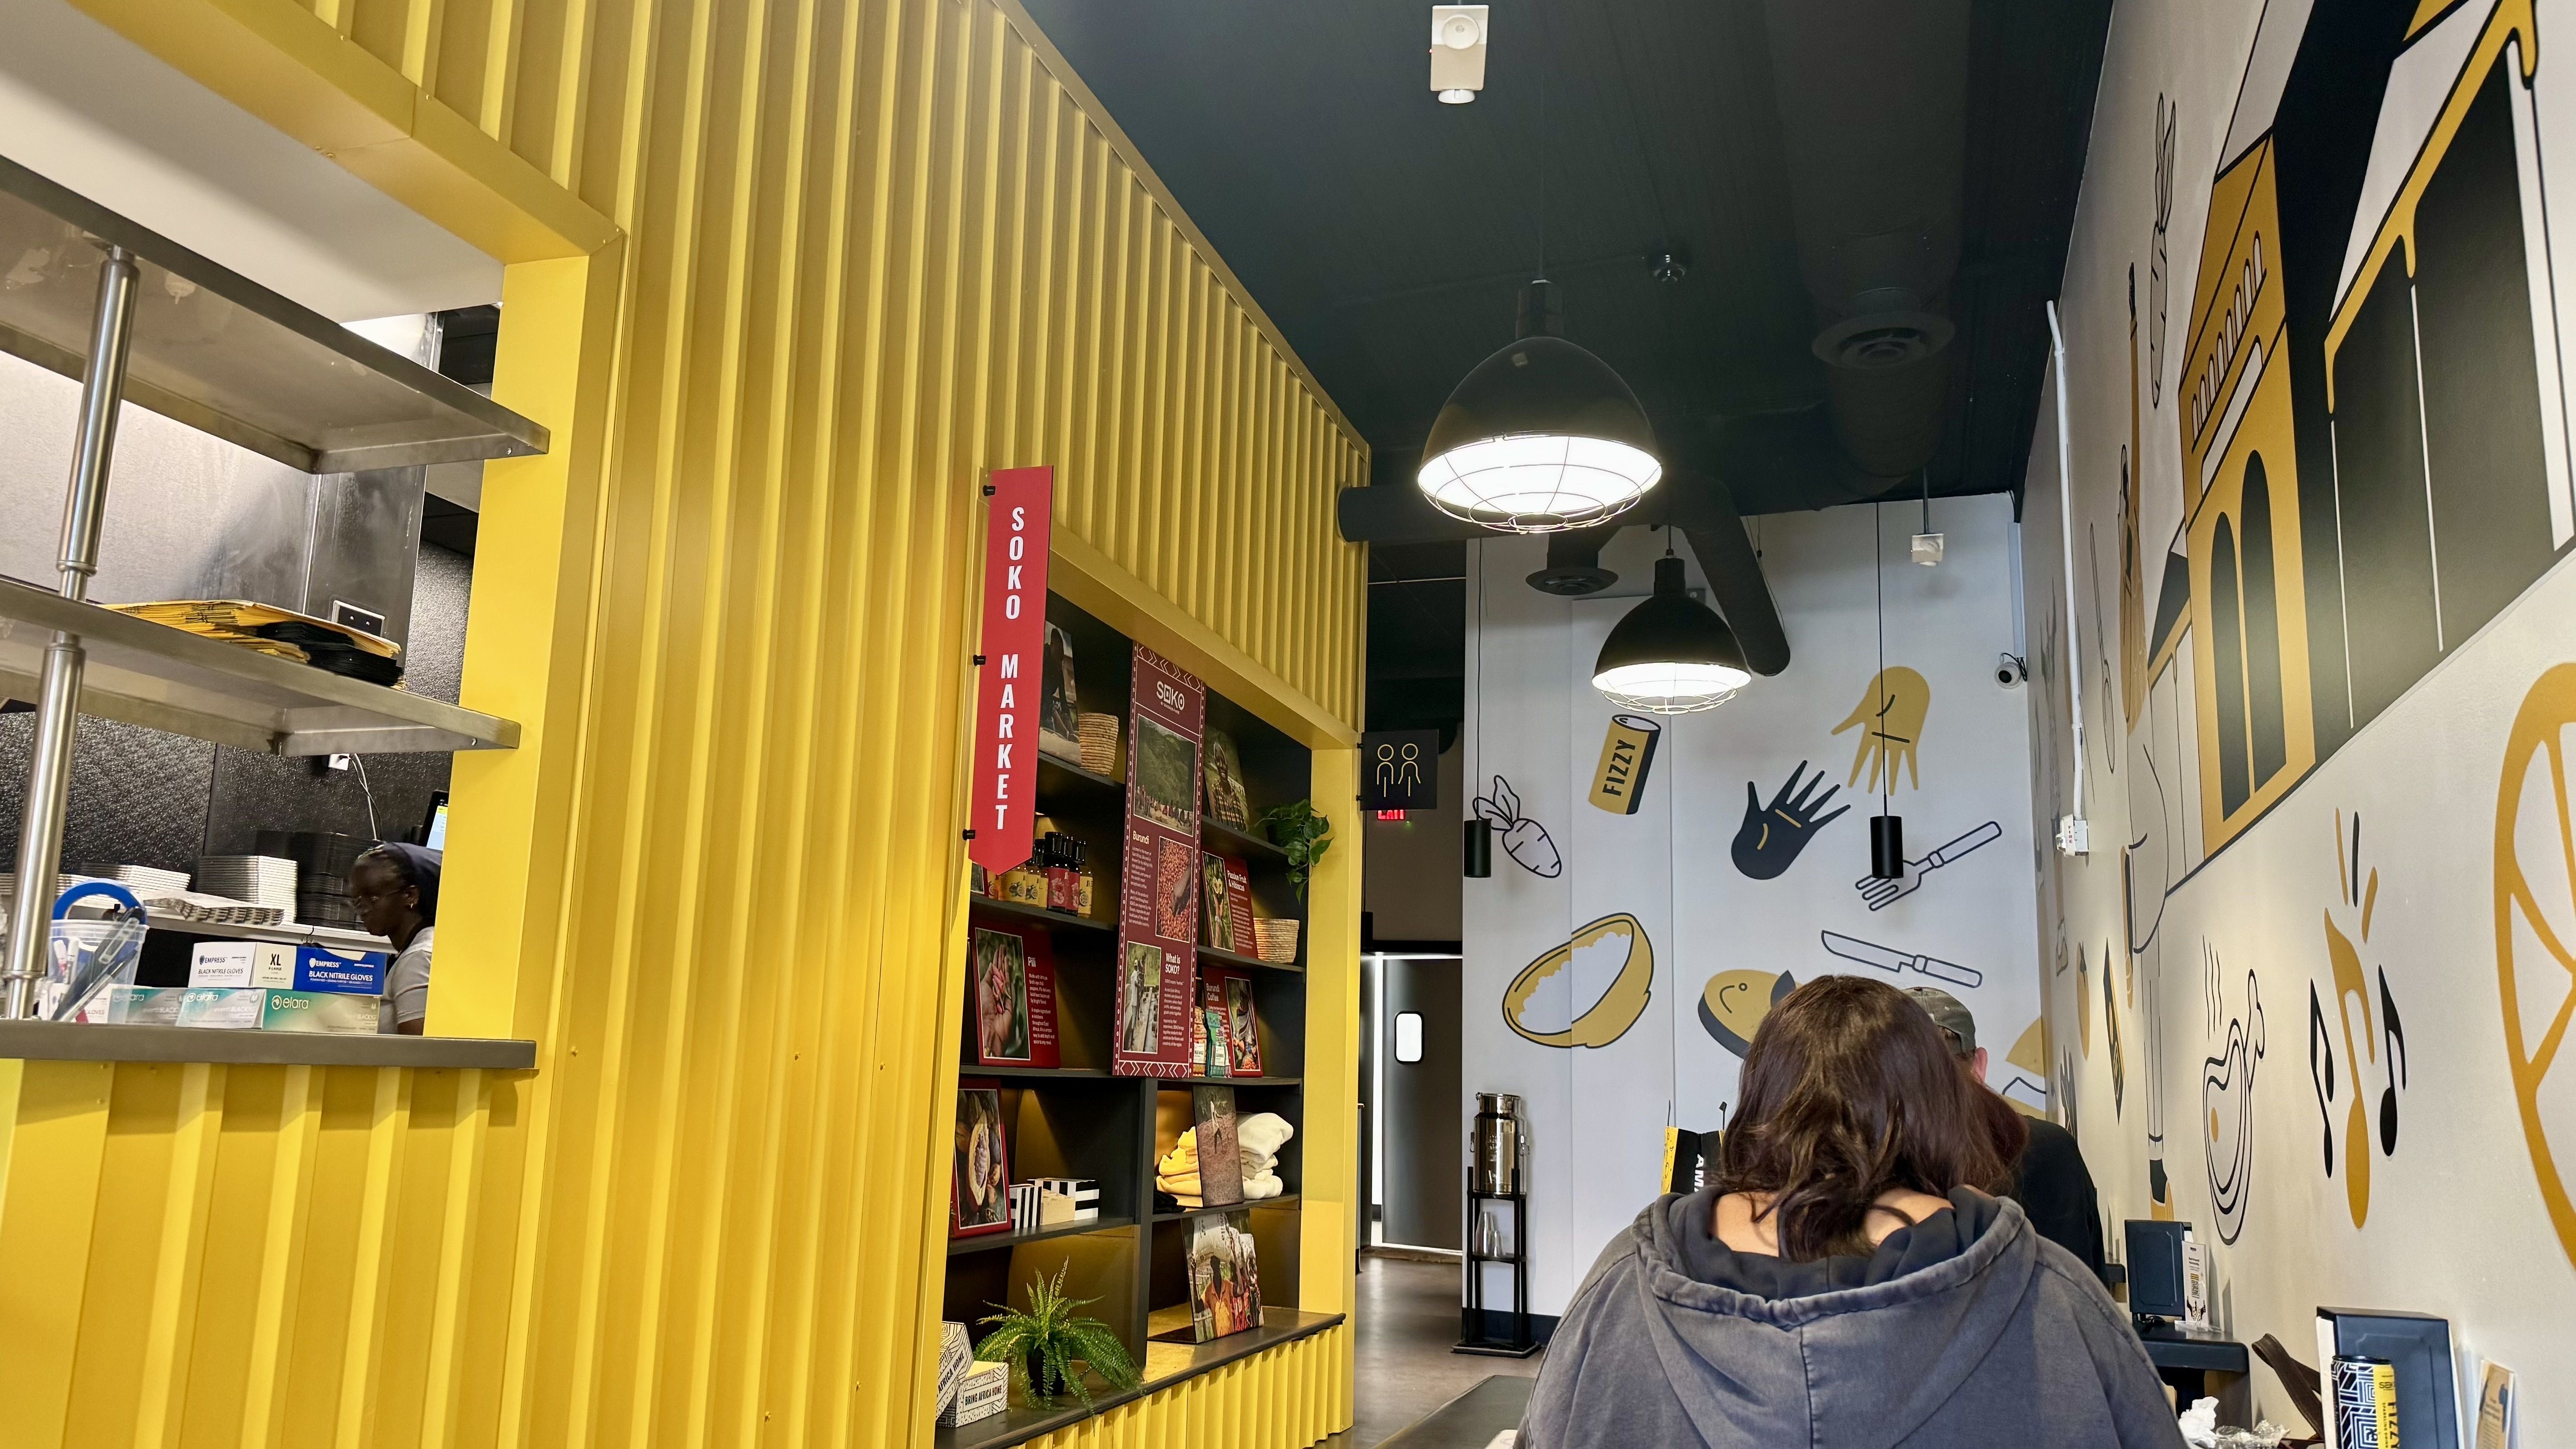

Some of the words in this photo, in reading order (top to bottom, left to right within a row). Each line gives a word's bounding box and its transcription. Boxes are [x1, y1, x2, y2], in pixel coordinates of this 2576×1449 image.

[1006, 507, 1024, 619] SOKO
[1156, 681, 1185, 711] SOKO
[996, 654, 1018, 829] MARKET
[1602, 739, 1635, 796] FIZZY
[1132, 830, 1150, 845] Burundi
[270, 953, 281, 966] XL
[316, 960, 339, 968] EMPRESS
[1028, 956, 1037, 967] Pili
[1166, 952, 1177, 963] What
[1177, 954, 1181, 964] is
[309, 970, 329, 979] BLACK
[329, 972, 350, 980] NITRILE
[1165, 964, 1180, 975] SOKO?
[1206, 983, 1220, 993] Burundi
[283, 997, 309, 1010] elara
[1207, 992, 1219, 1002] Coffee
[1694, 1154, 1705, 1192] AM
[938, 1368, 954, 1394] AFRICA
[953, 1349, 965, 1372] HOME
[965, 1393, 978, 1406] BRING
[978, 1388, 992, 1401] AFRICA
[992, 1384, 1002, 1396] HOME
